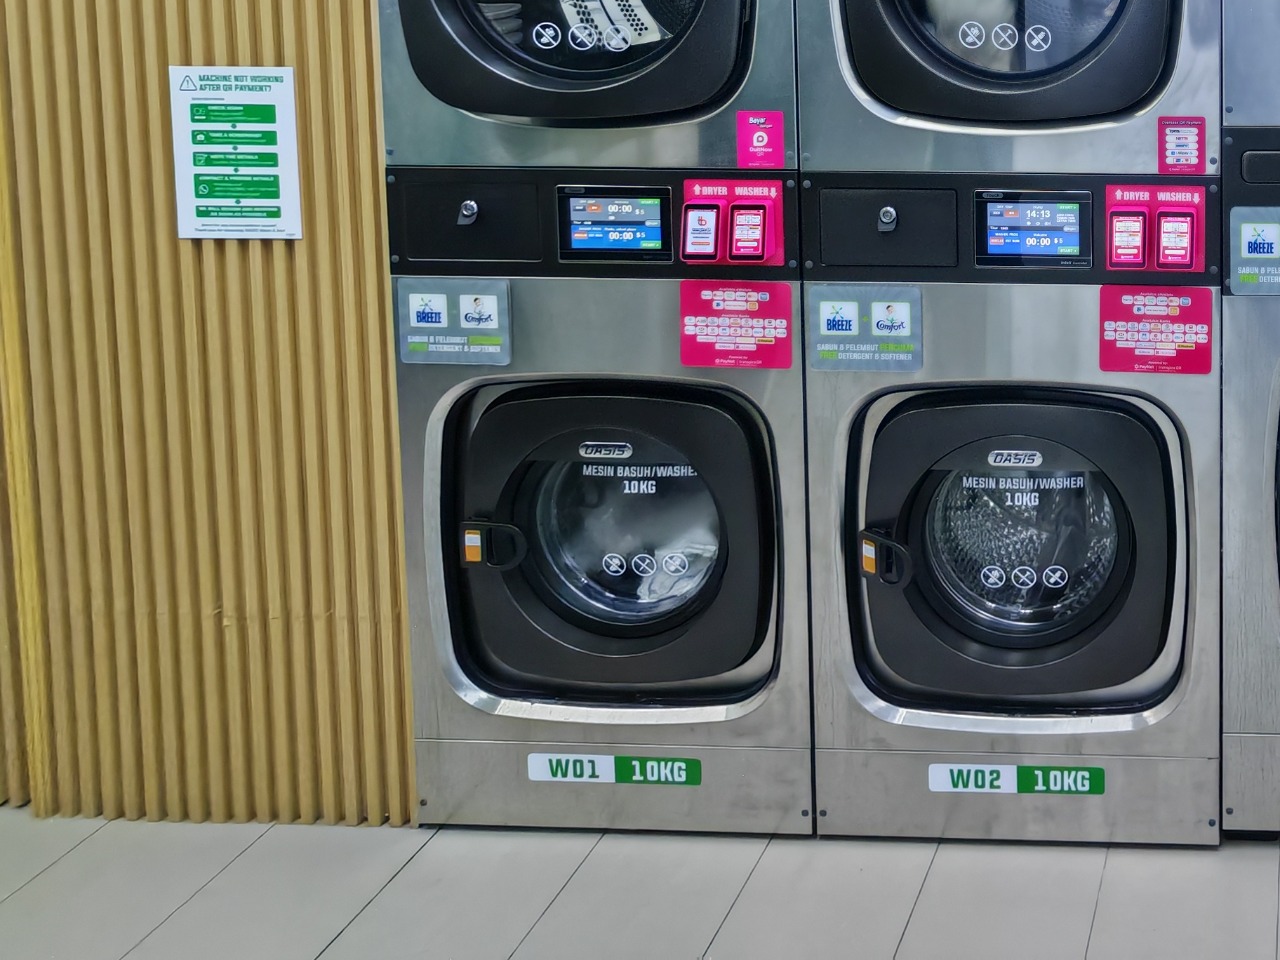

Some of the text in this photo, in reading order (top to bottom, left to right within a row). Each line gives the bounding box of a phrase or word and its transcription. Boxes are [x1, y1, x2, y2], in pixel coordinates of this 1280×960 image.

[702, 186, 769, 196] DRYER WASHER
[1123, 191, 1192, 202] DRYER WASHER
[608, 204, 633, 212] 00:00
[1026, 210, 1051, 218] 14:13
[608, 232, 634, 240] 00:00
[1026, 237, 1051, 246] 00:00
[1247, 241, 1274, 255] BREEZE
[826, 318, 852, 331] BREEZE
[876, 319, 906, 333] Comfort
[816, 343, 838, 351] SABUN
[838, 352, 873, 360] DETERGENT
[881, 353, 912, 361] SOFTENER
[582, 464, 698, 478] MESIN BASUH/WASHE
[623, 480, 656, 494] 10KG
[962, 477, 1084, 489] MESIN BASUH/WASHER
[1005, 492, 1040, 506] 10KG
[548, 758, 687, 782] W01 10KG
[949, 768, 1090, 792] W02 10KG
